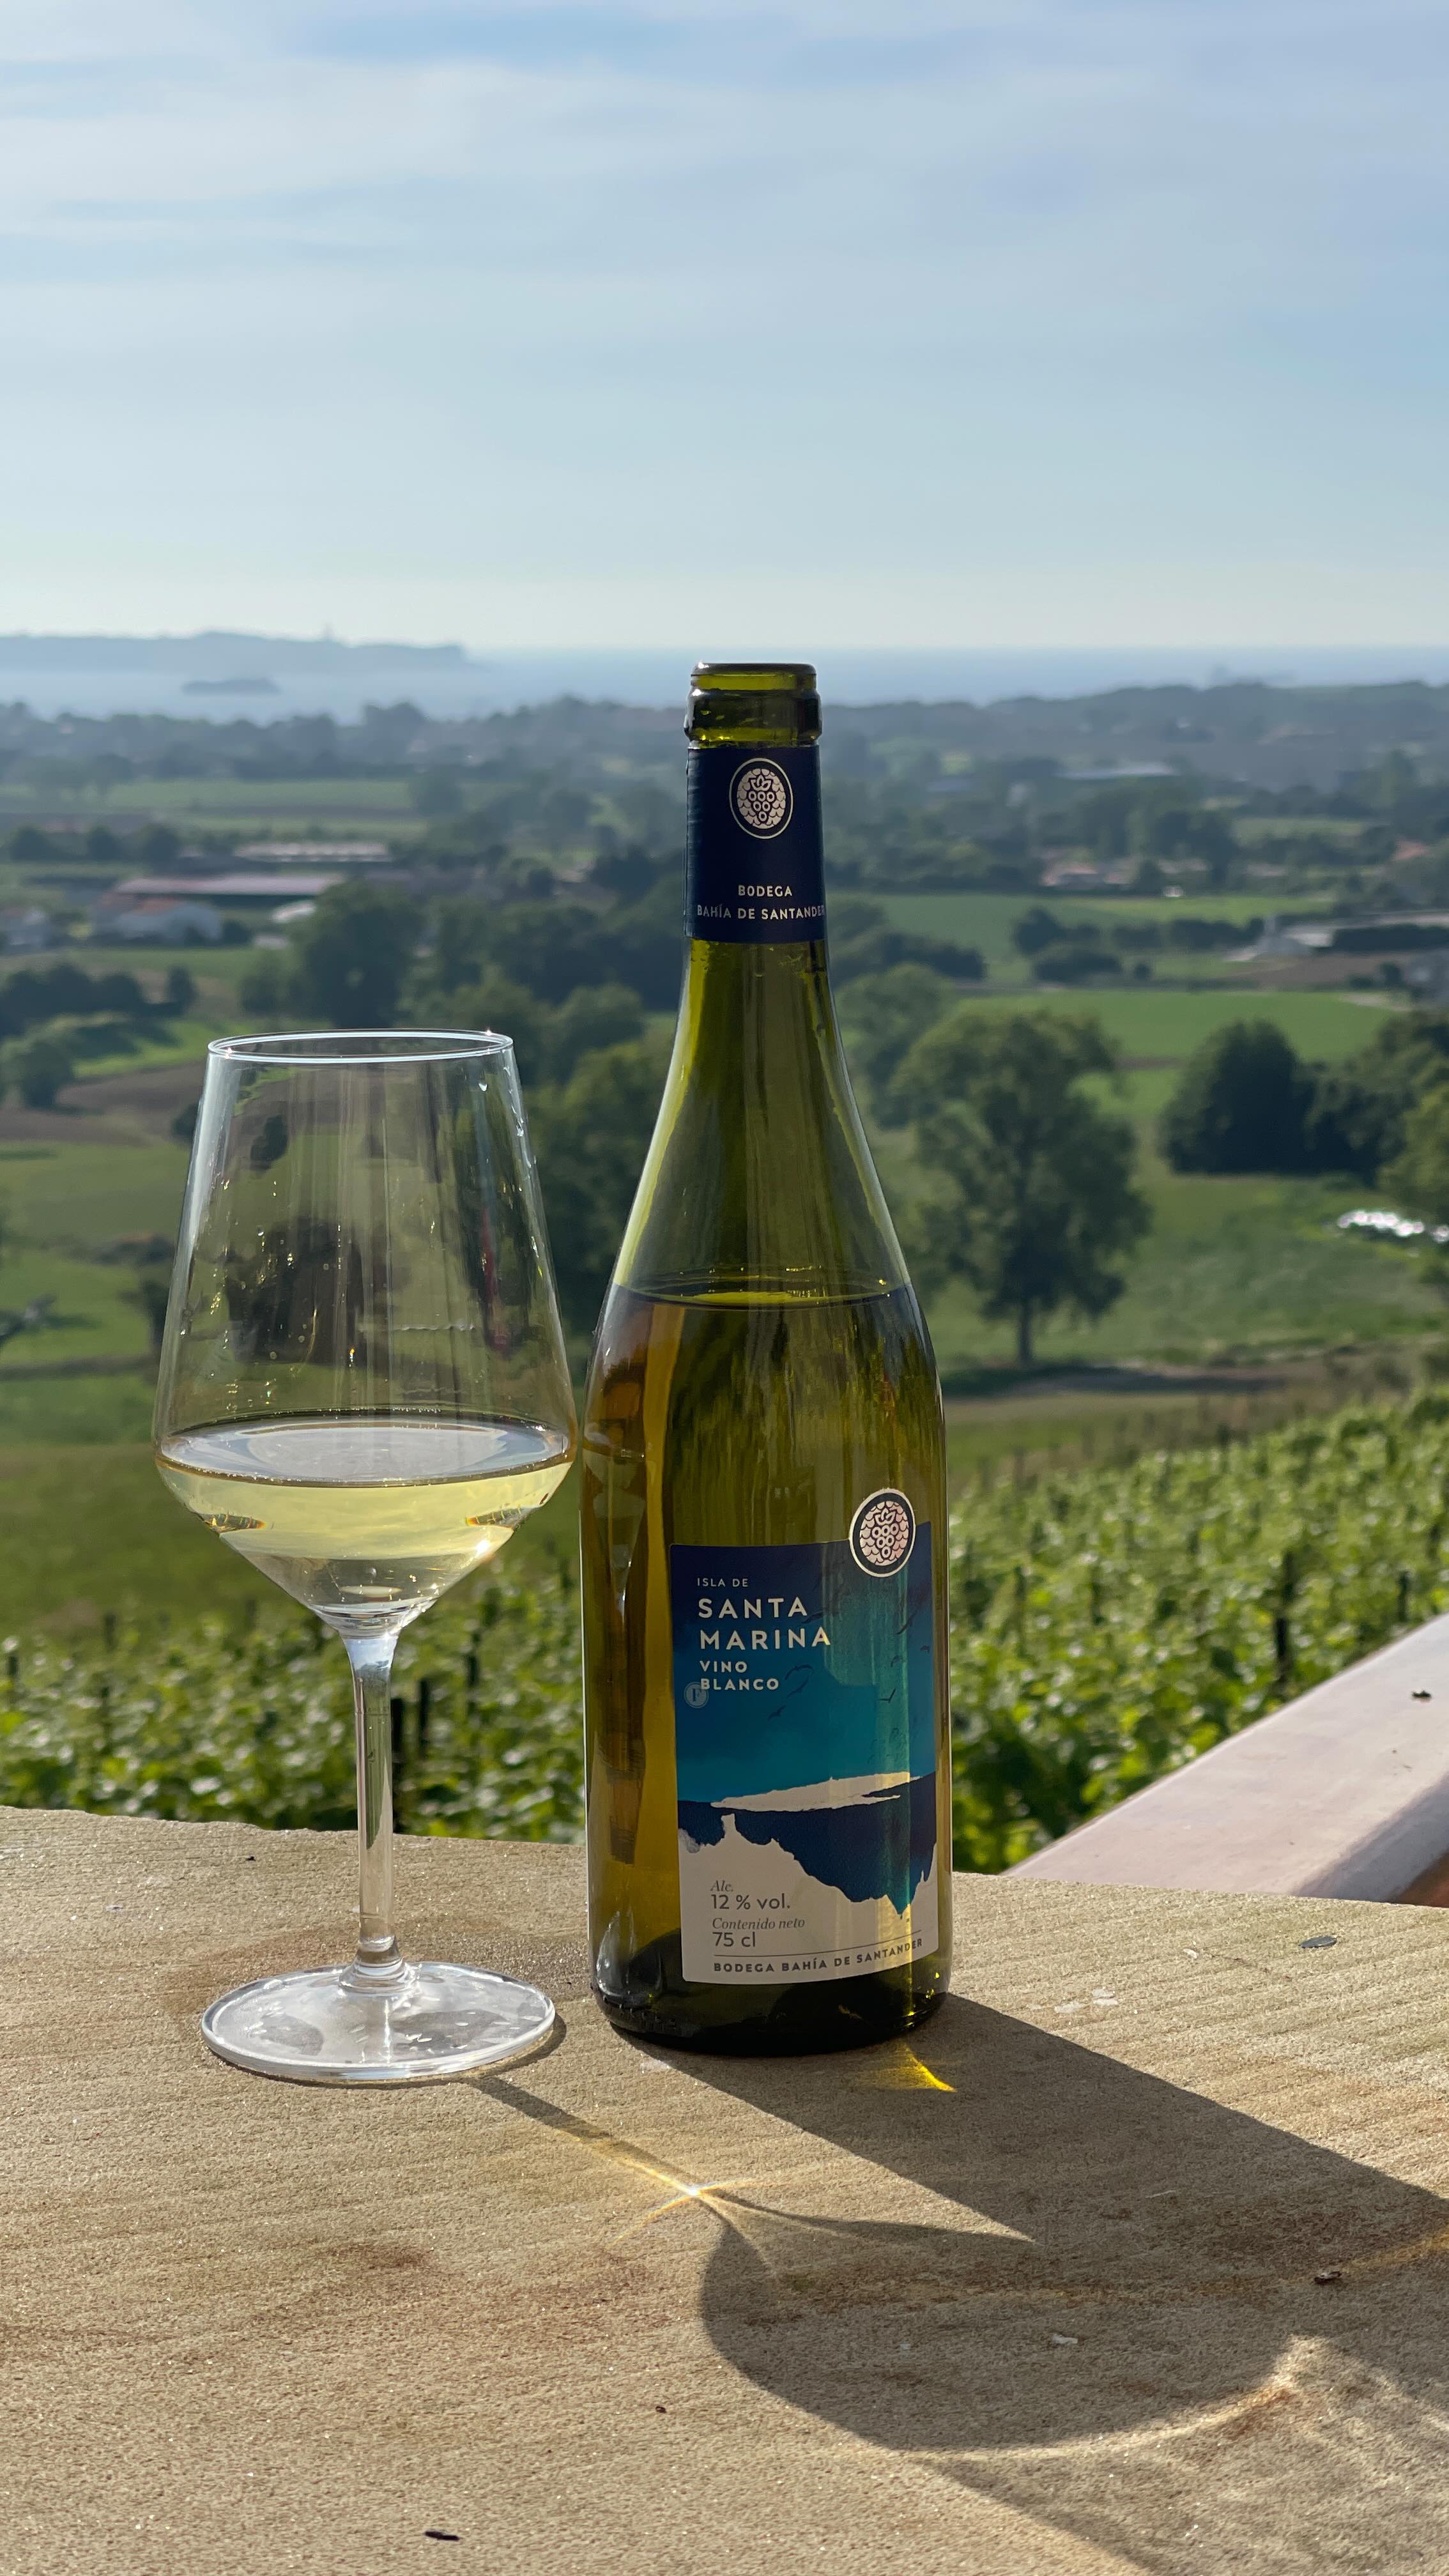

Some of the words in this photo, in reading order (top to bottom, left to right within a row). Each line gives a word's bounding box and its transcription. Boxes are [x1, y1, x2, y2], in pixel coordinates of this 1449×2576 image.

[738, 885, 793, 897] BODEGA
[696, 903, 732, 919] BAHÍA
[738, 908, 756, 919] DE
[697, 1577, 726, 1588] ISLA
[732, 1578, 749, 1588] DE
[698, 1597, 808, 1620] SANTA
[700, 1627, 831, 1650] MARINA
[699, 1660, 748, 1673] VINO
[700, 1678, 779, 1691] BLANCO
[710, 1879, 733, 1892] Alc.
[710, 1894, 730, 1910] 12
[736, 1894, 751, 1910] %
[756, 1894, 791, 1910] vol.
[712, 1917, 776, 1930] Contenido
[778, 1919, 805, 1929] neto
[712, 1932, 734, 1947] 75
[740, 1931, 756, 1947] cl
[714, 1963, 774, 1973] BODEGA
[782, 1958, 827, 1972] BAHÍA
[834, 1956, 850, 1967] DE
[856, 1938, 923, 1963] SANTANDER
